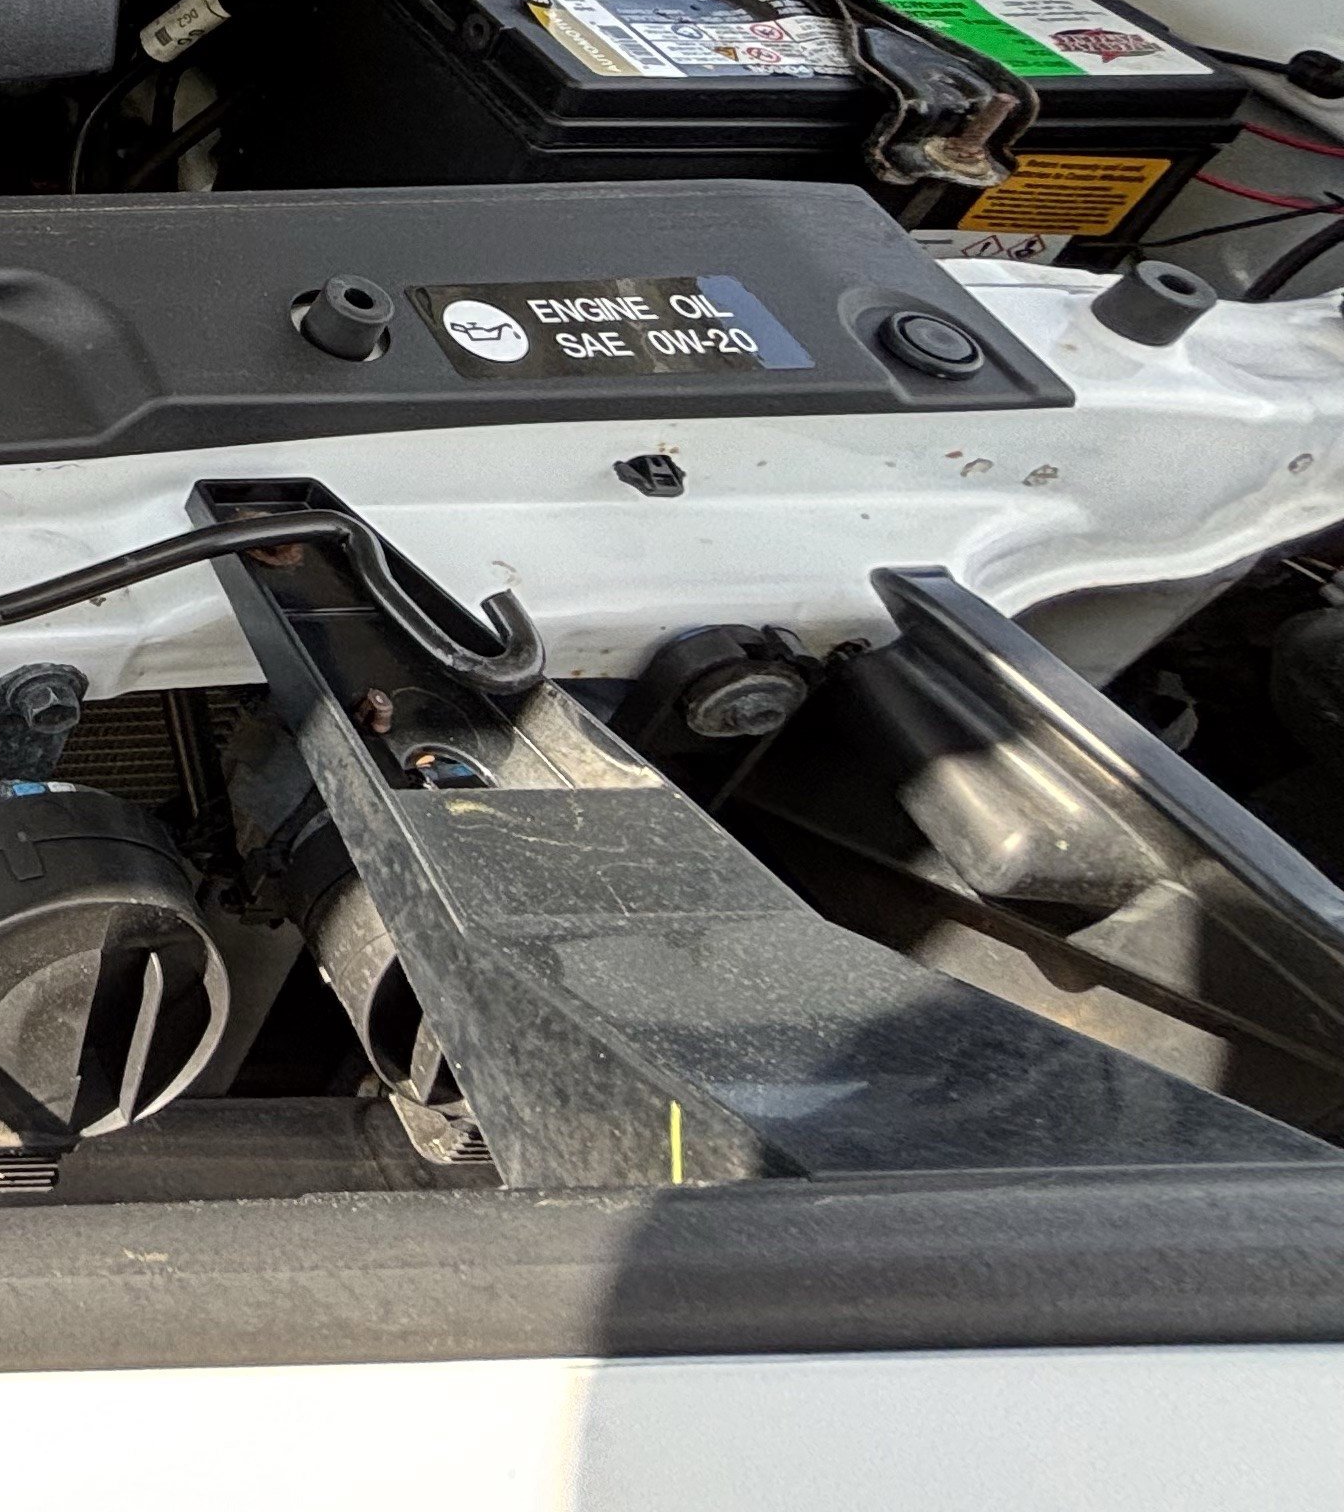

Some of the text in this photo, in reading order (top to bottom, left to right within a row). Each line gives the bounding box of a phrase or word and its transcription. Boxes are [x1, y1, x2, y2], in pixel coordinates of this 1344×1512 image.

[526, 293, 735, 324] ENGINE OIL
[555, 328, 760, 359] SAE 0W-20
